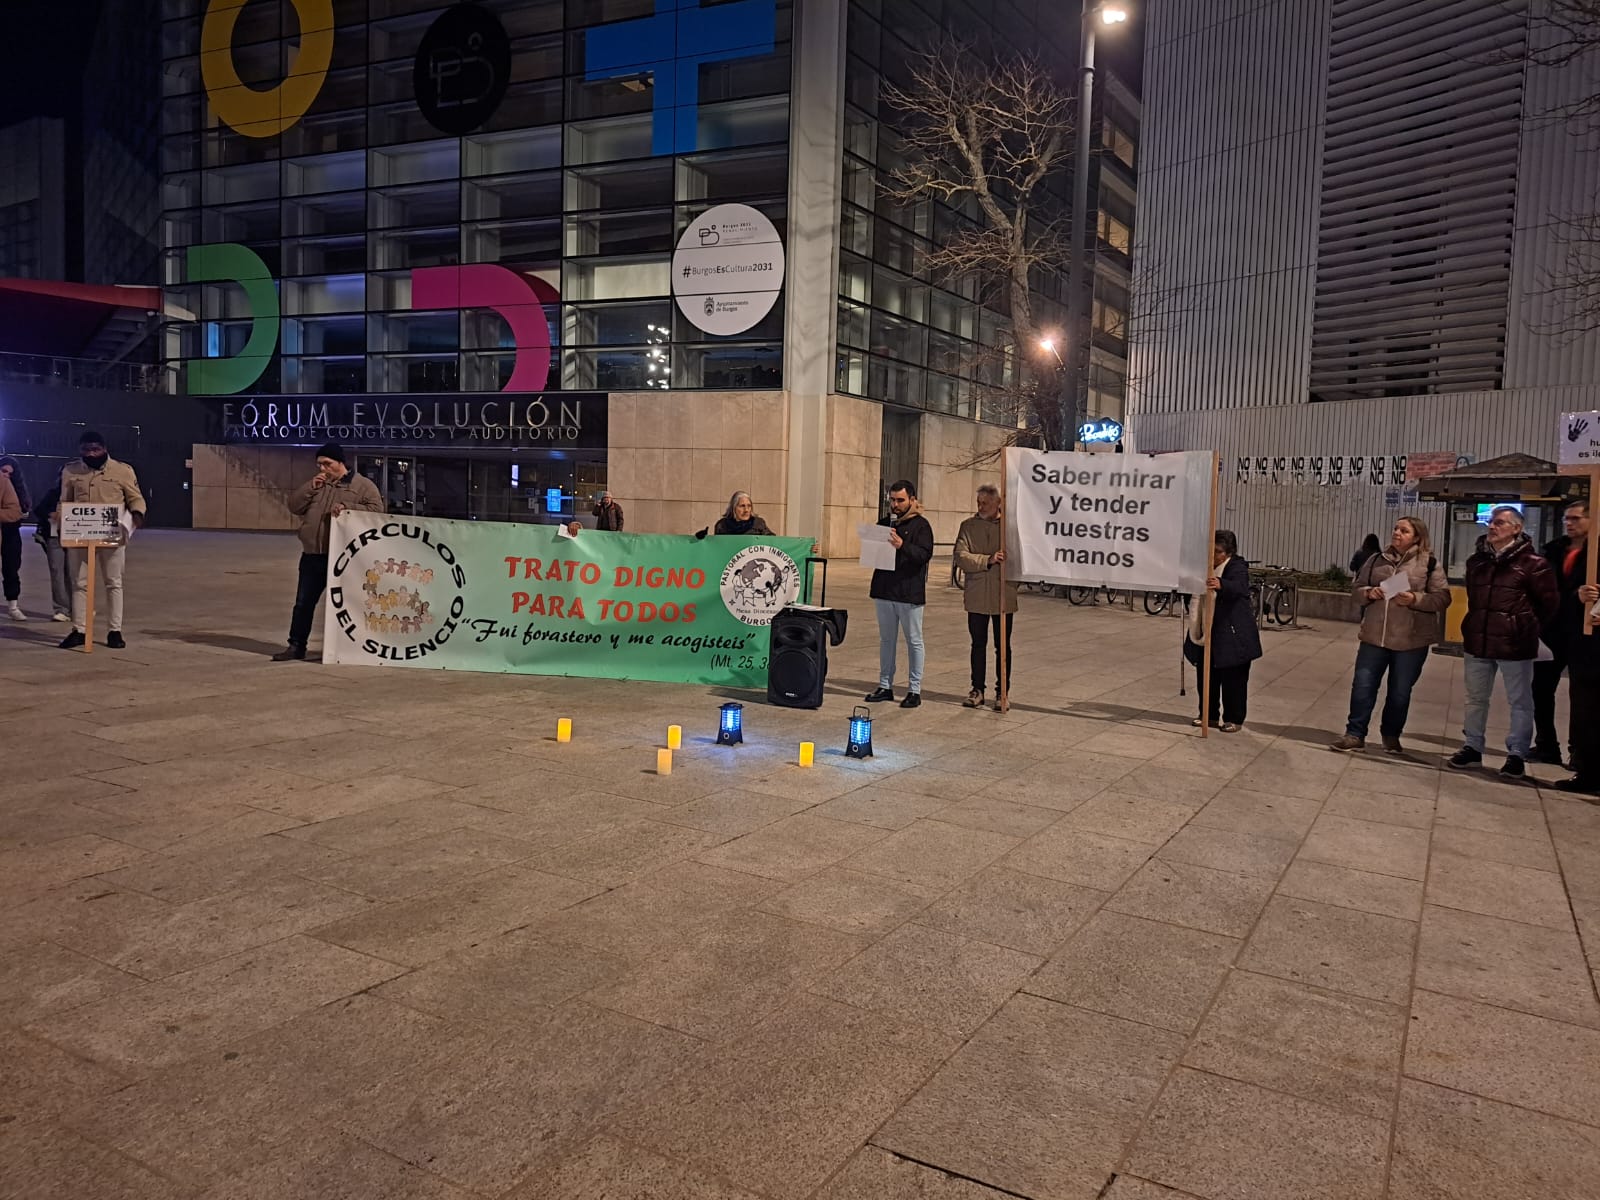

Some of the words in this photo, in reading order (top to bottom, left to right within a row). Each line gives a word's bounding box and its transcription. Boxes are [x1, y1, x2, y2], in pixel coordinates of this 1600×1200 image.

[682, 262, 773, 279] #BurgosEsCultura2031
[223, 398, 329, 427] FÓRUM
[353, 395, 582, 429] EVOLUCIÓN
[223, 425, 290, 438] PALACIO
[298, 426, 317, 439] DE
[326, 425, 436, 439] CONGRESOS
[449, 427, 456, 439] Y
[469, 426, 580, 440] AUDITORIO
[1590, 439, 1600, 447] hu
[1238, 456, 1250, 471] NO
[1255, 456, 1268, 471] NO
[1272, 456, 1286, 471] NO
[1291, 456, 1304, 471] NO
[1309, 456, 1323, 471] NO
[1329, 456, 1343, 471] NO
[1350, 456, 1364, 471] NO
[1370, 456, 1385, 471] NO
[1392, 456, 1407, 471] NO
[1031, 463, 1103, 487] Saber
[1109, 468, 1176, 490] mirar
[1328, 471, 1342, 485] NO
[1370, 471, 1384, 485] NO
[1390, 471, 1406, 485] NO
[71, 507, 97, 516] CIES
[1049, 496, 1064, 515] y
[1070, 493, 1151, 515] tender
[1044, 520, 1150, 542] nuestras
[333, 522, 466, 589] CIRCULOS
[720, 552, 746, 586] PASTORAL
[748, 545, 765, 554] CON
[768, 546, 800, 588] INMIGRANTES
[1054, 547, 1135, 568] manos
[504, 556, 601, 585] TRATO
[613, 565, 706, 590] DIGNO
[511, 591, 586, 621] PARA
[597, 599, 698, 624] TODOS
[330, 586, 356, 642] DEL
[362, 595, 464, 661] SILENCIO
[740, 615, 772, 626] BURGO
[522, 622, 602, 646] forastero
[610, 632, 620, 648] y
[628, 633, 655, 646] me
[710, 653, 734, 671] (Mt.
[736, 655, 756, 671] 25,
